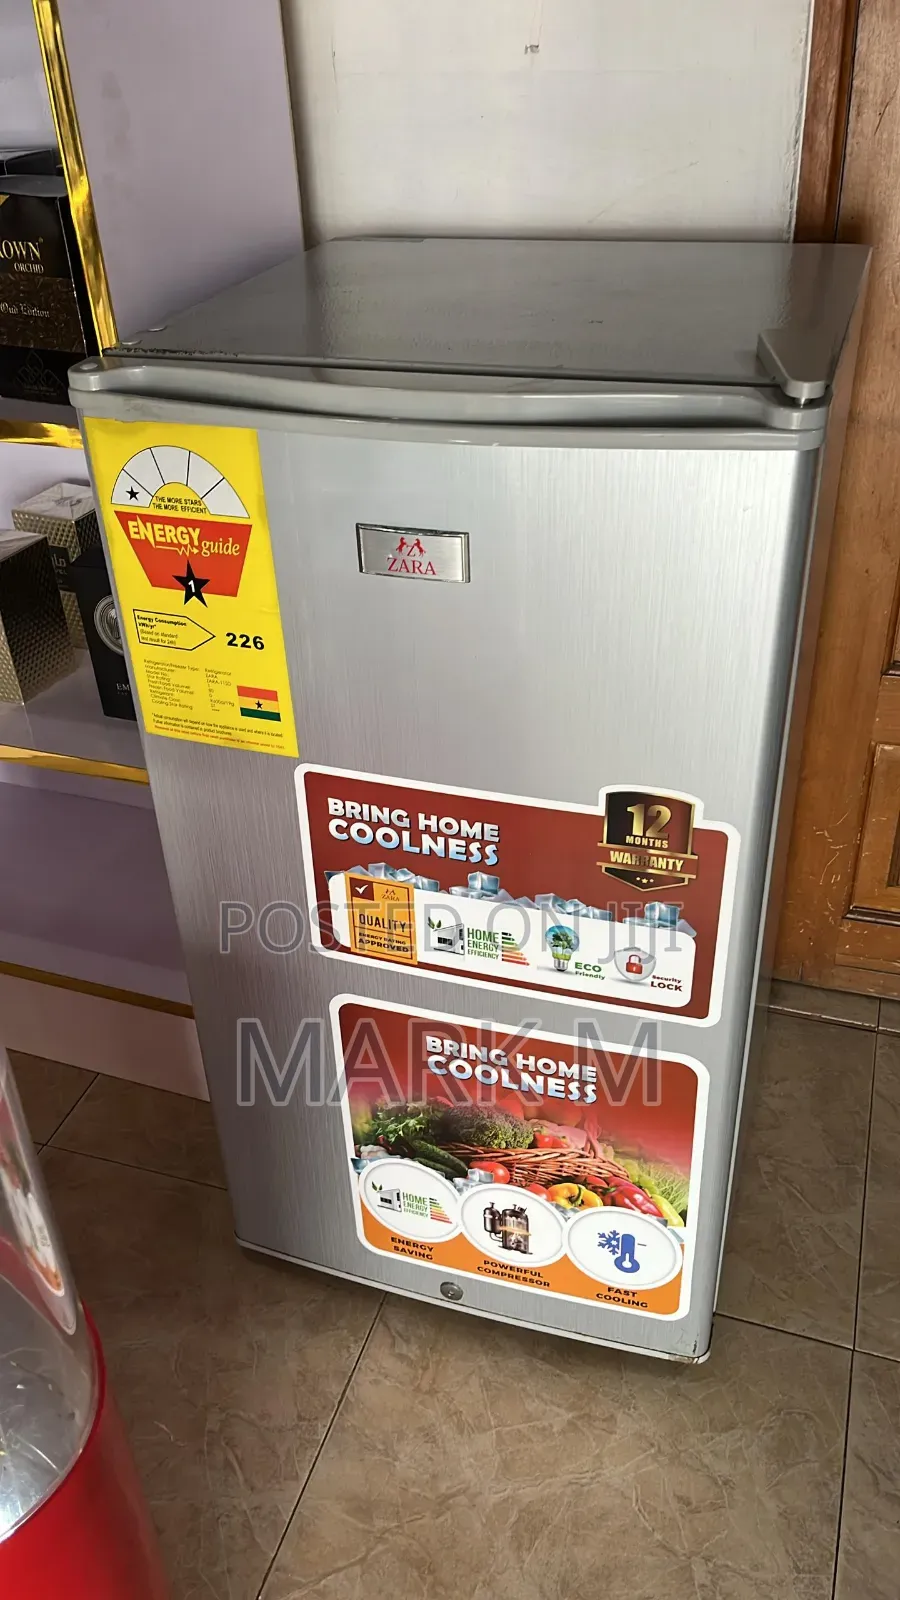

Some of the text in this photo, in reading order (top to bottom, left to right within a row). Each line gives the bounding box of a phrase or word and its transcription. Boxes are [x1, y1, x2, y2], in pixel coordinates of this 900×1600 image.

[14, 262, 44, 274] ORCHID
[20, 303, 51, 318] Edition
[167, 497, 183, 505] MORE
[184, 498, 202, 506] STARS
[181, 506, 207, 514] EFFICIENT
[127, 515, 240, 557] ENERGY guide
[387, 556, 437, 576] ZARA
[188, 580, 196, 593] 1
[137, 614, 187, 626] Energy Consumption
[225, 632, 265, 651] 226
[327, 797, 500, 843] BRING HOME
[626, 803, 672, 839] 12
[328, 818, 499, 866] COOLNESS
[625, 835, 669, 849] MONTHS
[609, 850, 685, 872] WARRANTY
[359, 913, 406, 933] QUALITY
[358, 932, 383, 941] ENERGY
[467, 927, 500, 944] HOME
[358, 938, 409, 953] APPROVED
[467, 940, 499, 953] ENERGY
[467, 949, 499, 960] EFFICIENCY
[574, 961, 602, 973] ECO
[575, 970, 606, 980] Friendly
[652, 975, 682, 984] Security
[650, 981, 683, 992] LOCK
[425, 1035, 597, 1084] BRING HOME
[427, 1054, 597, 1104] COOLNESS
[402, 1192, 428, 1205] HOME
[403, 1201, 428, 1212] ENERGY
[390, 1236, 434, 1252] ENERGY
[393, 1245, 433, 1260] SAVING
[483, 1259, 544, 1279] POWERFUL
[477, 1266, 550, 1288] COMPRESSOR
[607, 1286, 638, 1298] FAST
[596, 1292, 649, 1308] COOLING
